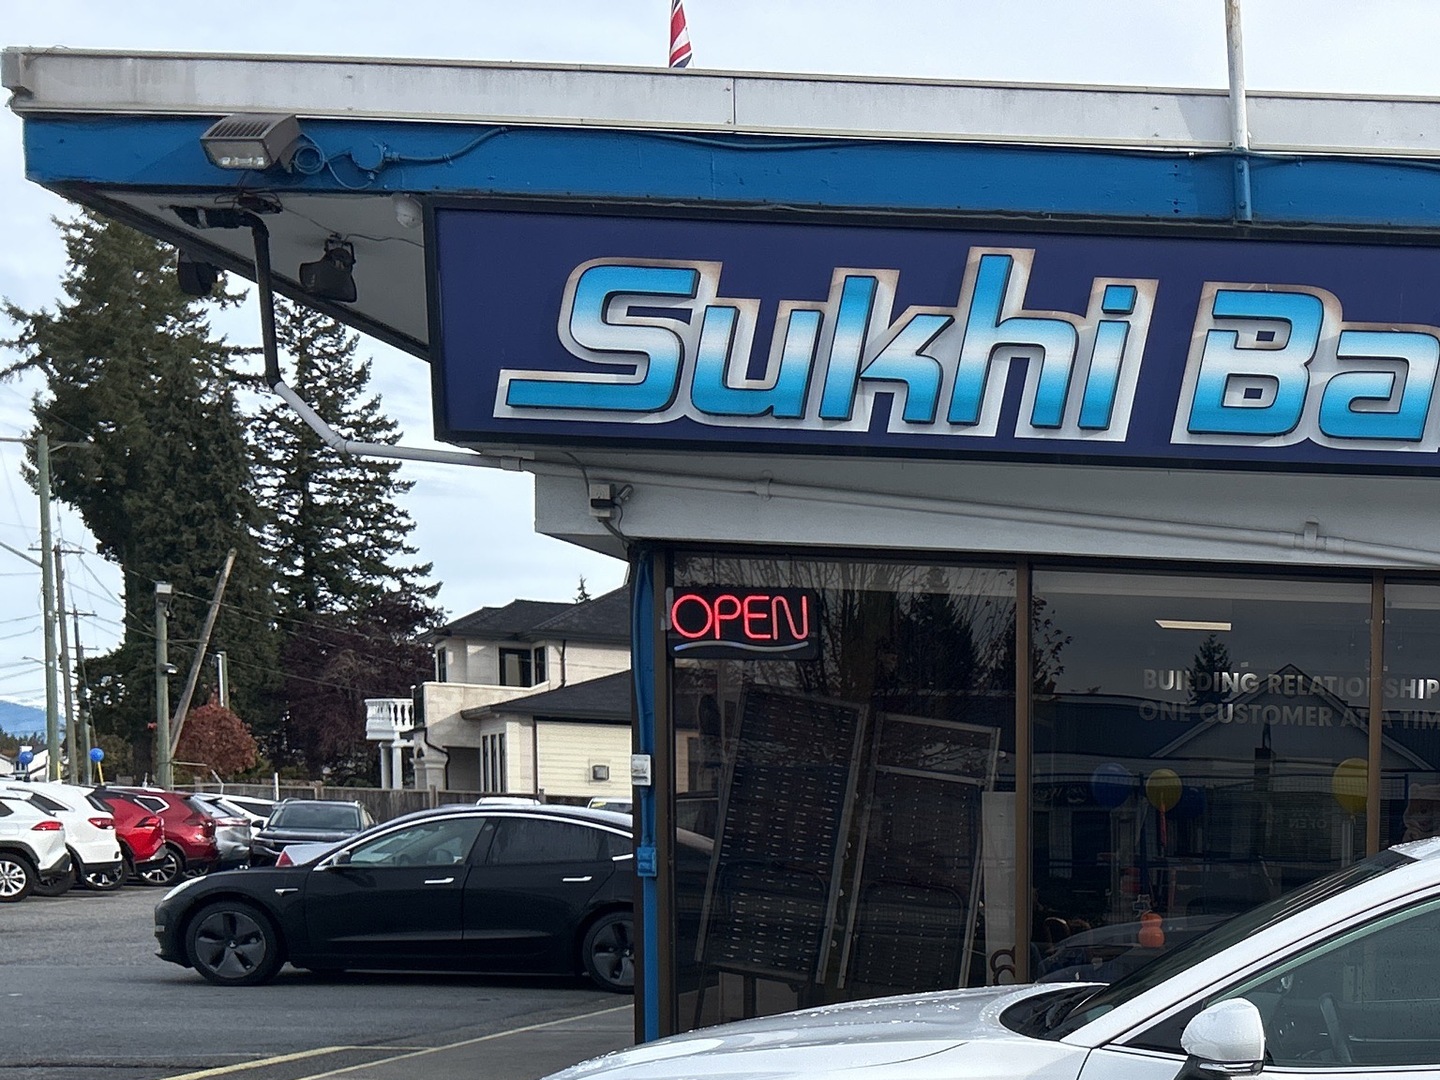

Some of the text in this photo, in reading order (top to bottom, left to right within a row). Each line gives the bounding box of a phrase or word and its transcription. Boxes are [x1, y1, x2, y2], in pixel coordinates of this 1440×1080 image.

[494, 247, 1158, 443] Sukhi
[669, 592, 809, 643] OPEN
[1138, 701, 1191, 722] ONE
[1199, 702, 1333, 727] CUSTOMER
